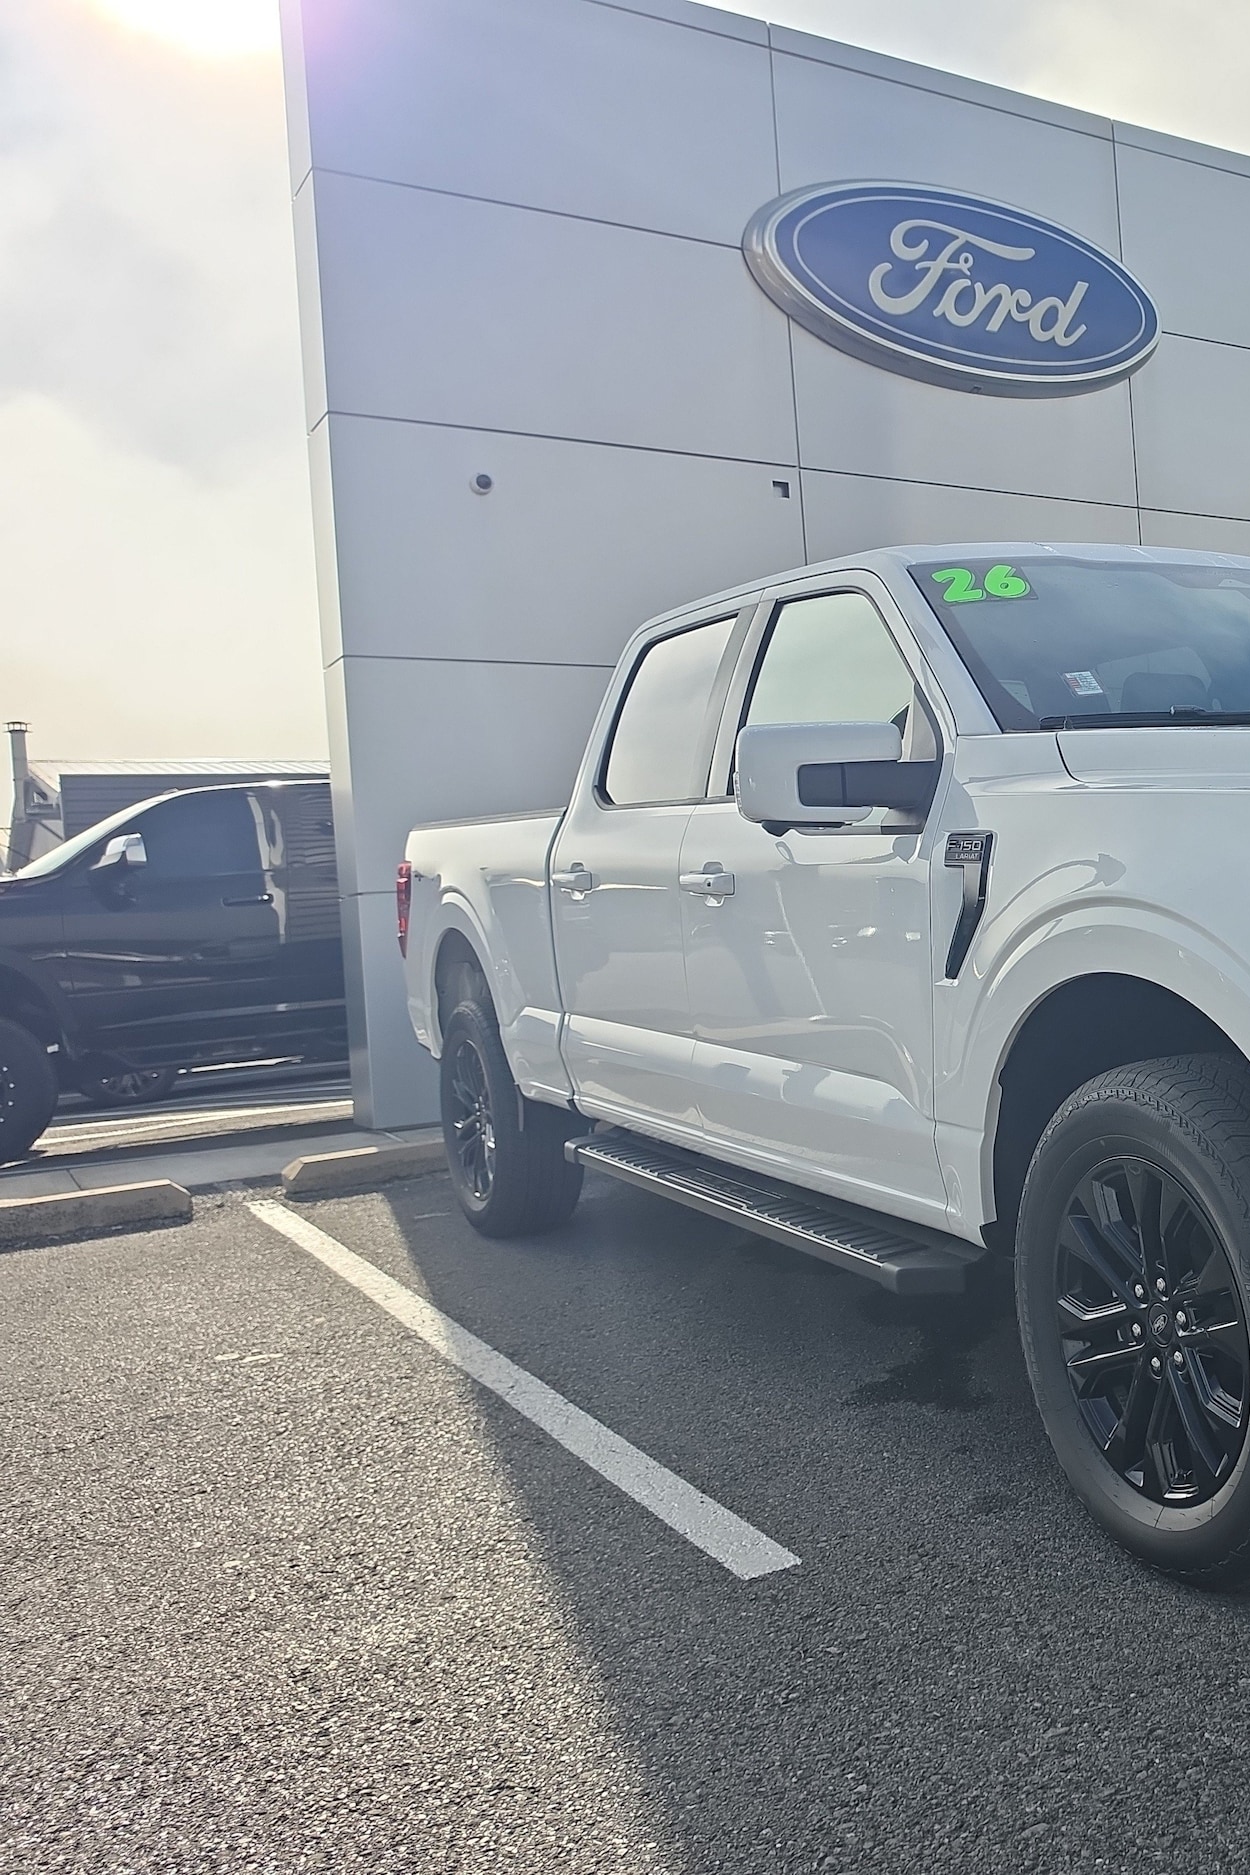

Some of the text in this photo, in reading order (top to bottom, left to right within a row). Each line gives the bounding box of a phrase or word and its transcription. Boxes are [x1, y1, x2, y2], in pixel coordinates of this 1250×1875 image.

[869, 218, 1090, 347] Ford
[931, 564, 1031, 603] 26
[947, 840, 982, 851] F-150
